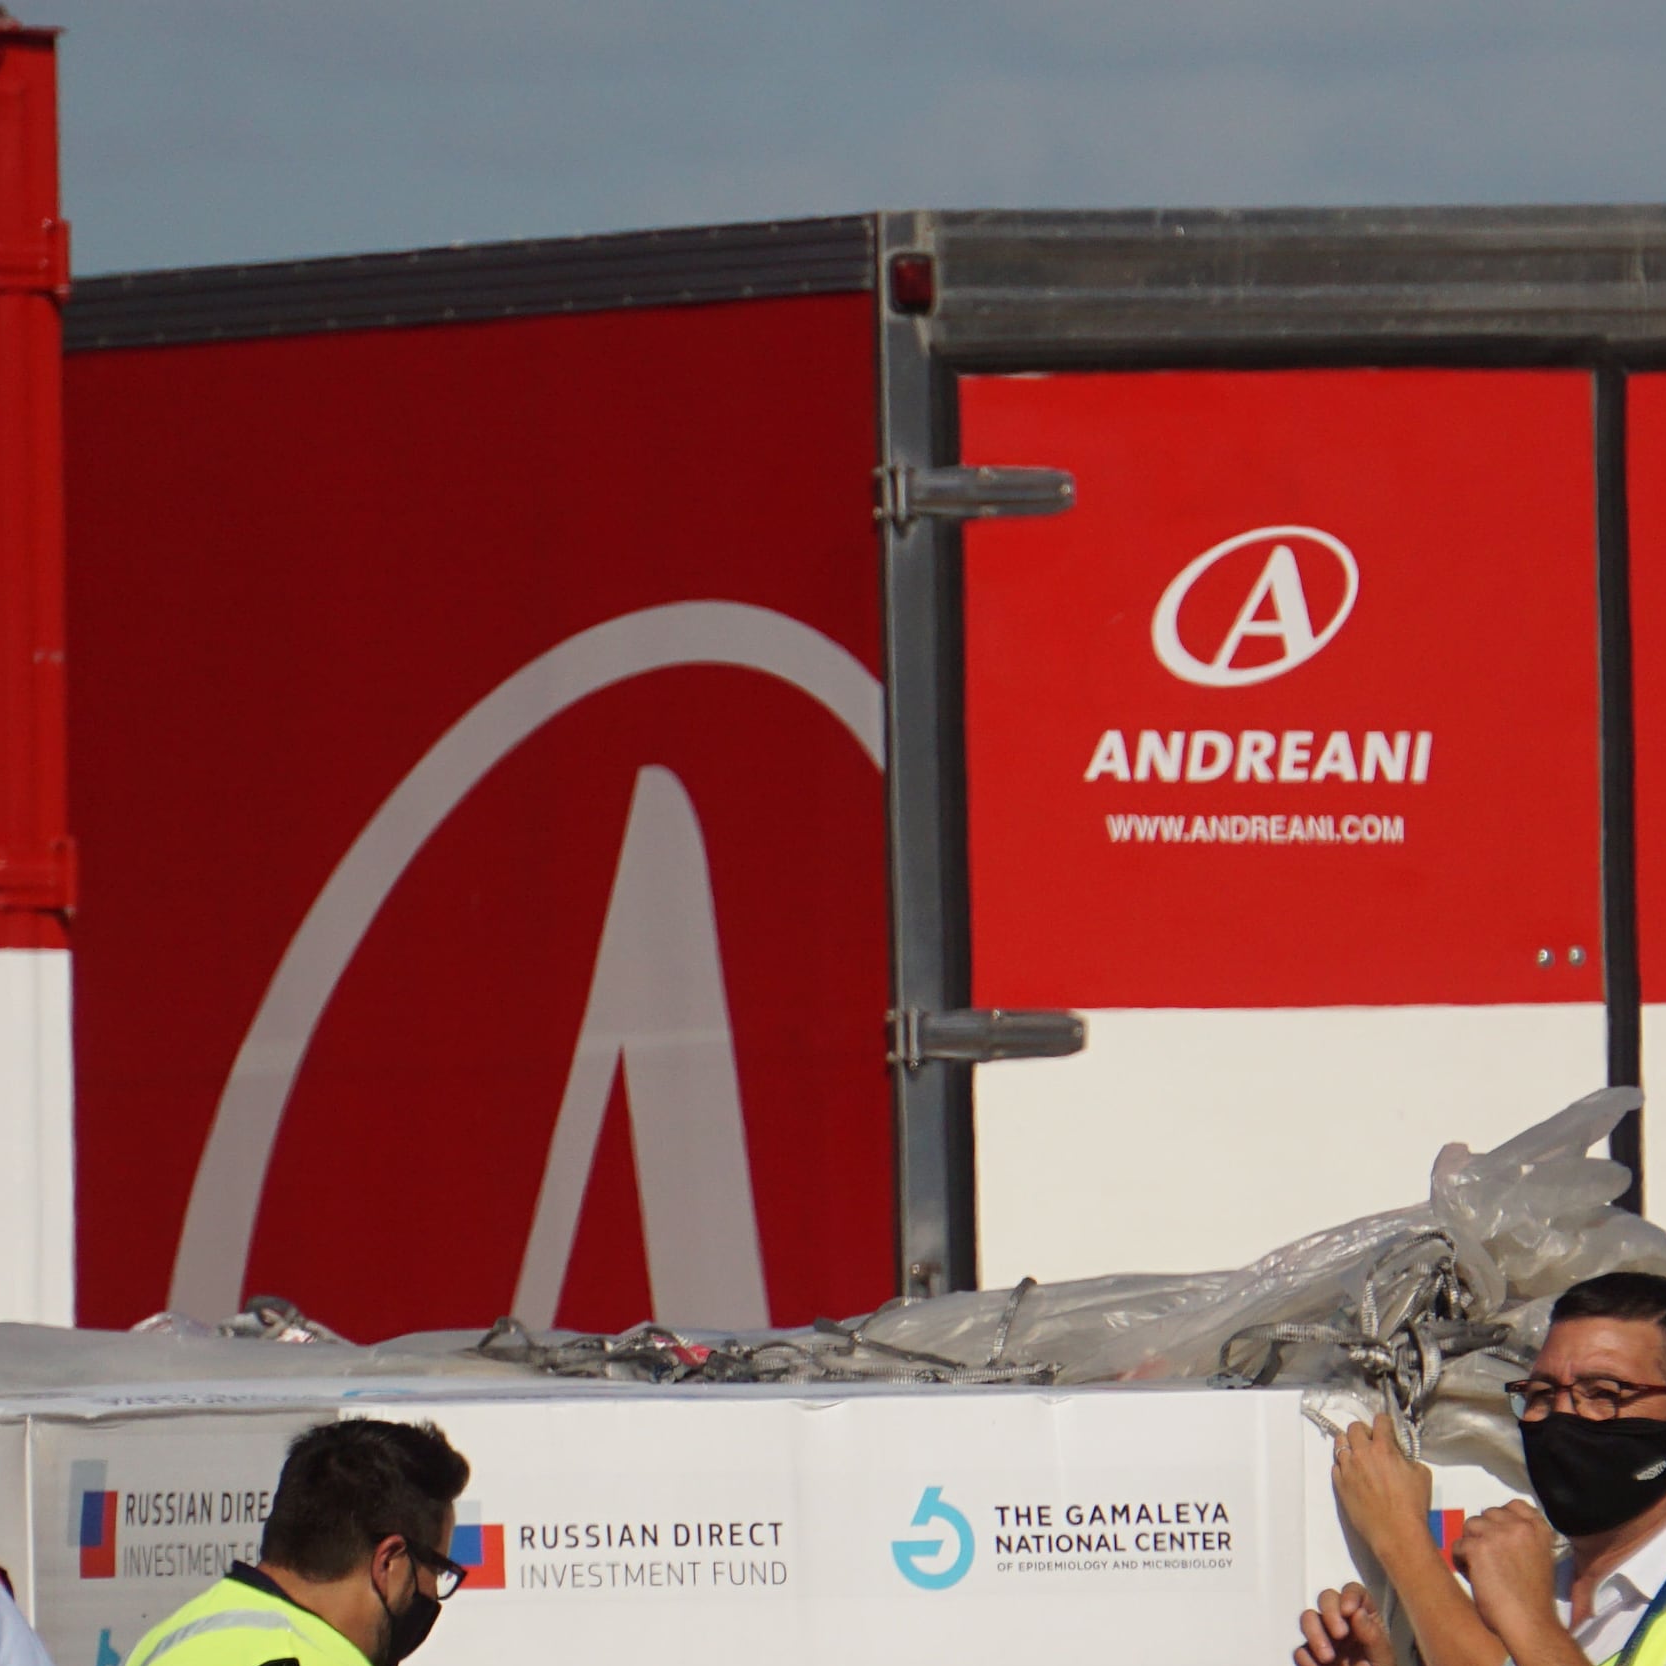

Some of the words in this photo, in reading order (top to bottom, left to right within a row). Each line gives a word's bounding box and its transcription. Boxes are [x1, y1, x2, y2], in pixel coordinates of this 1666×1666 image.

[1083, 729, 1433, 784] ANDREANI
[1106, 813, 1404, 844] WWW.ANDREANI.COM
[125, 1491, 213, 1526] RUSSIAN
[220, 1490, 270, 1523] DIRE
[995, 1505, 1053, 1527] THE
[1065, 1502, 1230, 1526] GAMALEYA
[520, 1523, 659, 1550] RUSSIAN
[673, 1521, 784, 1548] DIRECT
[996, 1534, 1127, 1554] NATIONAL
[1134, 1532, 1232, 1553] CENTER
[520, 1561, 702, 1588] INVESTMENT
[713, 1560, 788, 1586] FUND
[997, 1561, 1014, 1572] OF
[1018, 1560, 1108, 1572] EPIDEMIOLOGY
[1112, 1560, 1138, 1571] AND
[1142, 1558, 1233, 1570] MICROBIOLOGY
